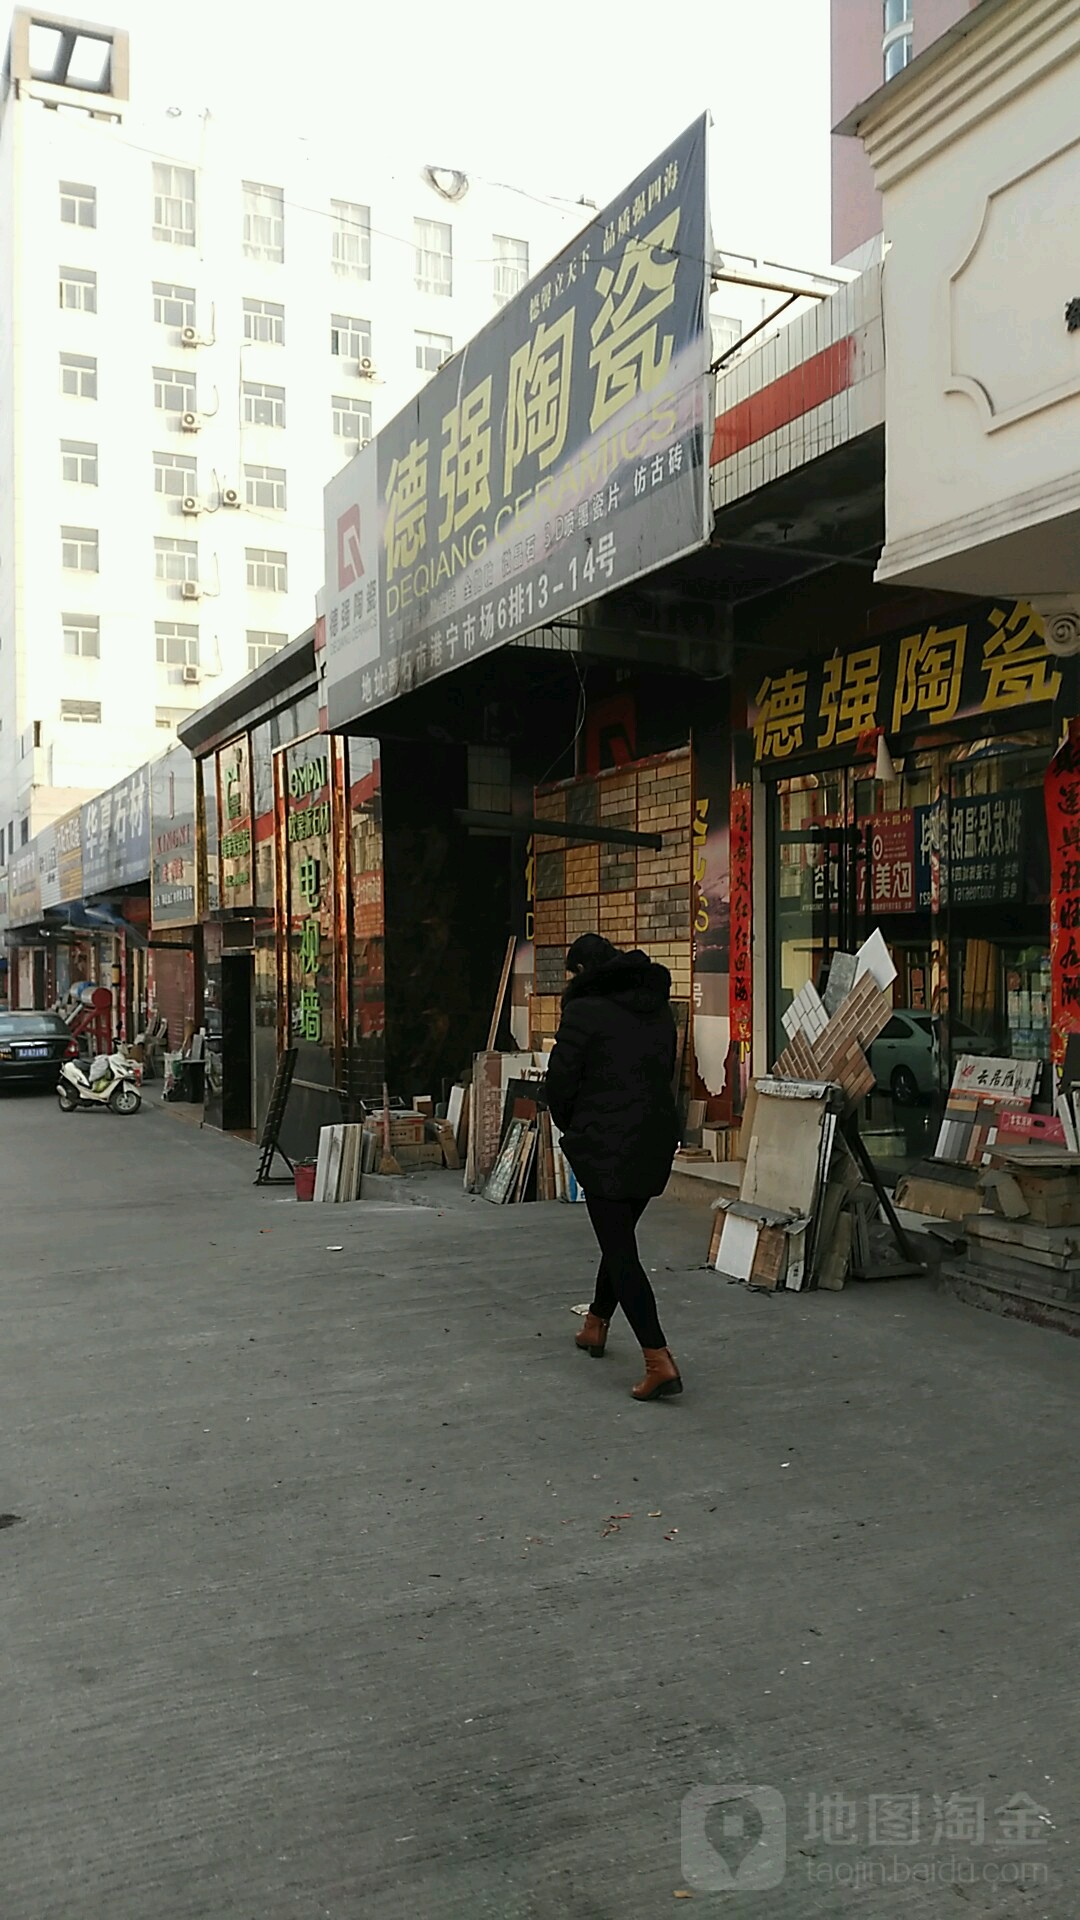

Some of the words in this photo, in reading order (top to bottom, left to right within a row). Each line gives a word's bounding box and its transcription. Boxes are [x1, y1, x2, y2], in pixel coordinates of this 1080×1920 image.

[602, 159, 679, 255] 品质强四海
[382, 206, 682, 582] 德强陶瓷
[633, 442, 683, 497] 仿古砖
[386, 519, 489, 619] DEQIANG
[493, 391, 680, 546] CERAMICS
[753, 598, 1063, 761] 德强陶瓷
[85, 773, 146, 859] 华夏石材
[299, 855, 322, 1043] 电视墙
